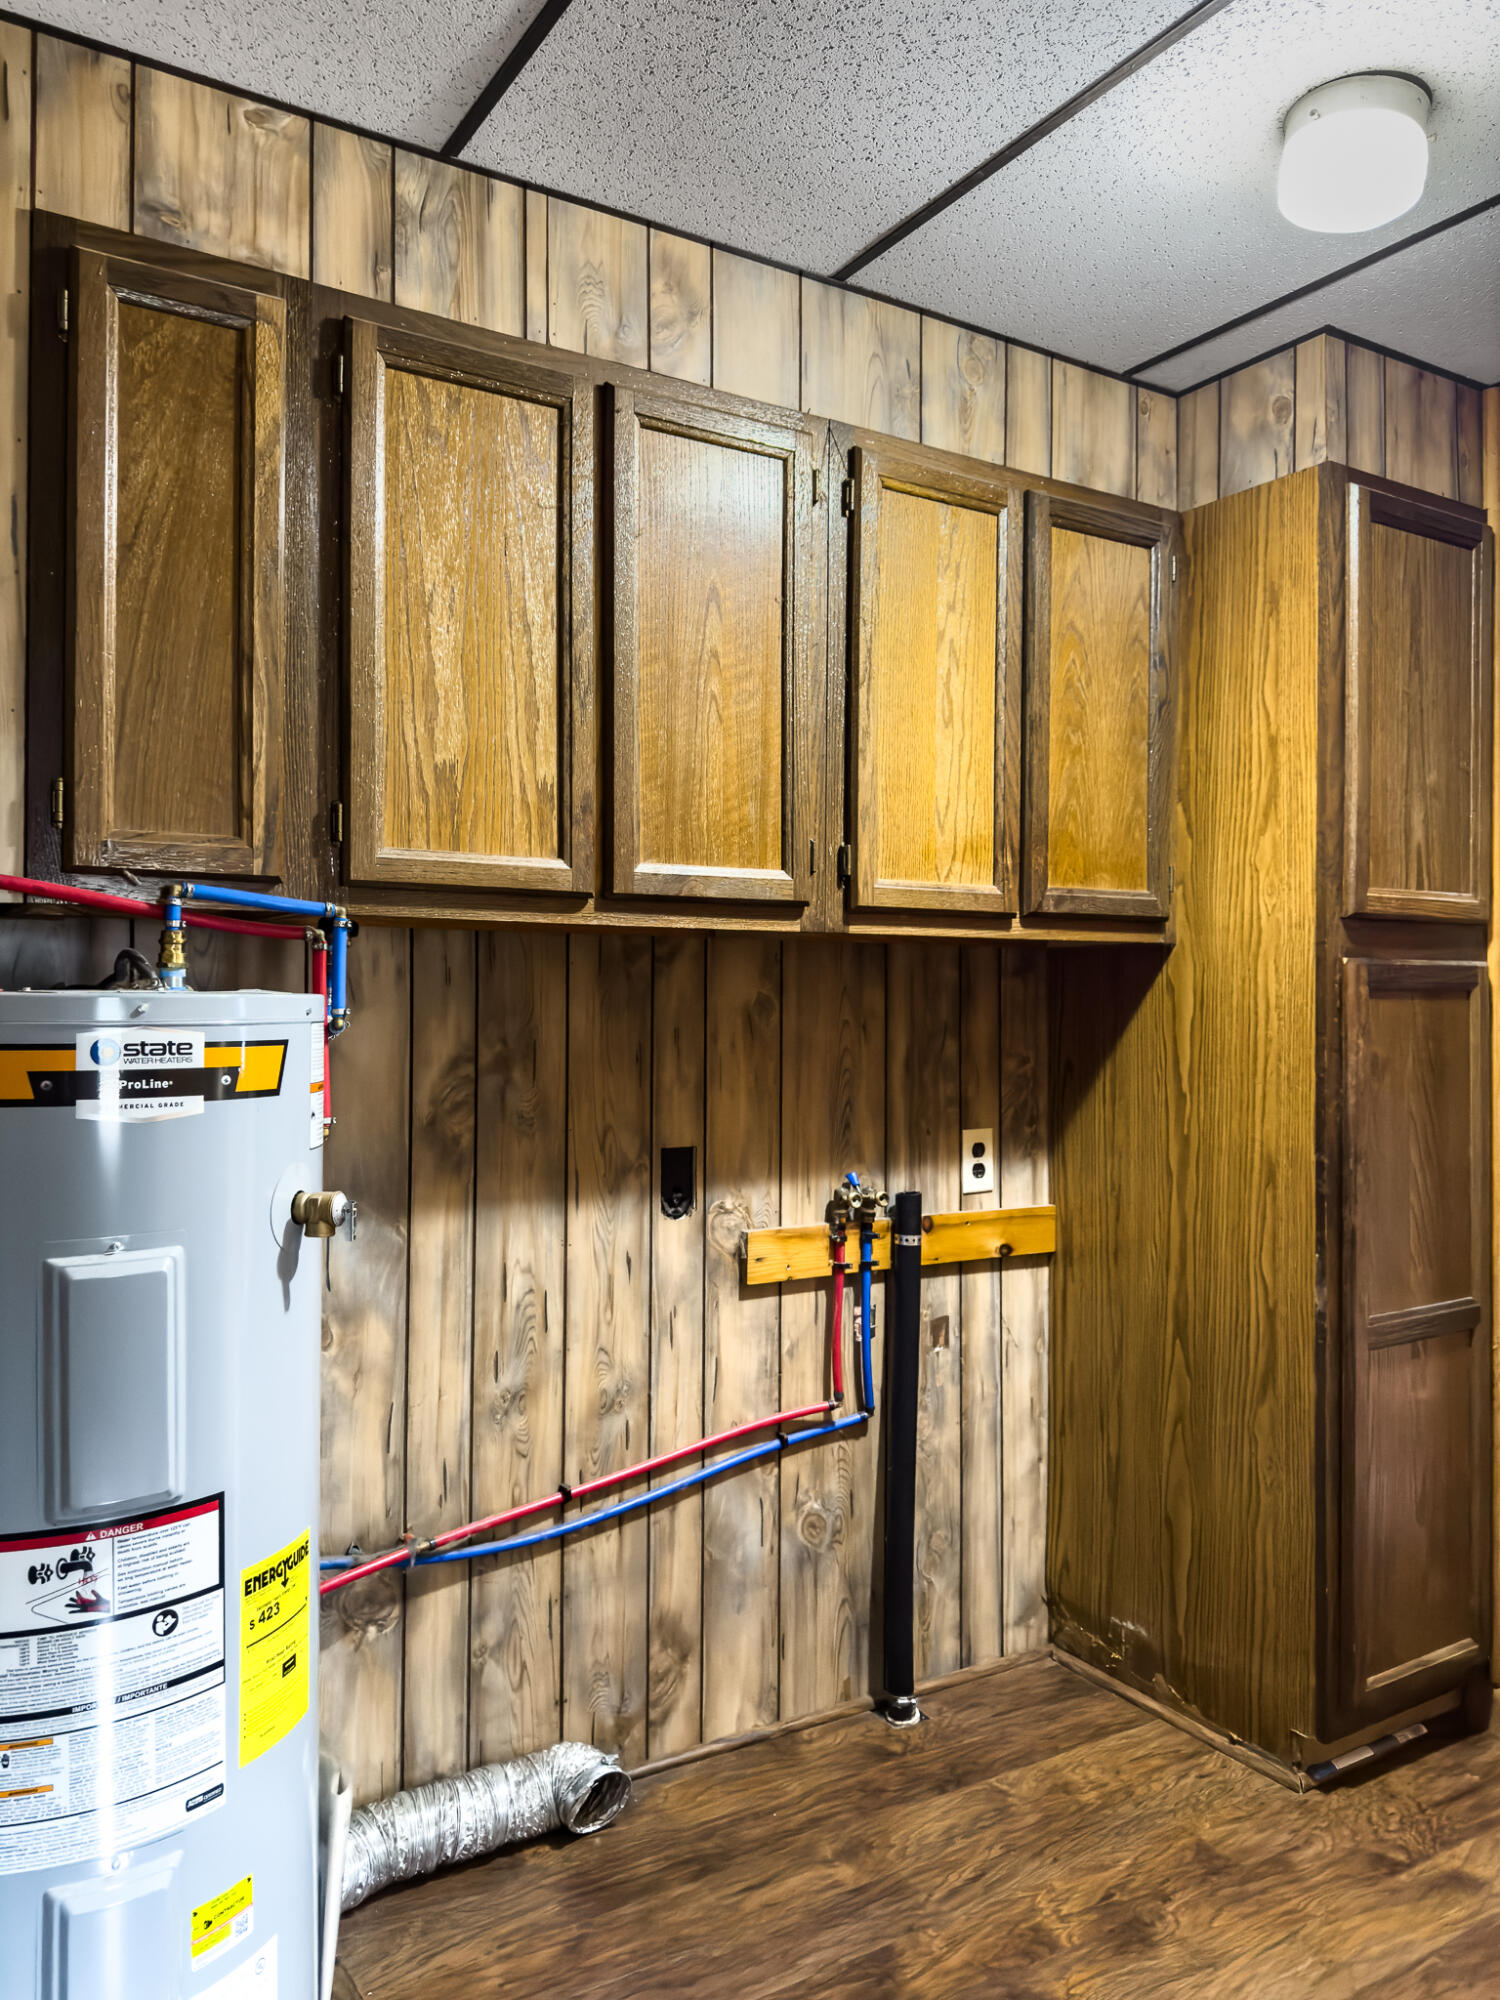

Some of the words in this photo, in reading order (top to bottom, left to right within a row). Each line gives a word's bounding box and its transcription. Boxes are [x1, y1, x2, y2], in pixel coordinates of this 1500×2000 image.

[123, 1041, 193, 1057] state
[155, 1056, 193, 1064] HEATERS
[99, 1523, 144, 1539] DANGER
[258, 1601, 281, 1624] 423
